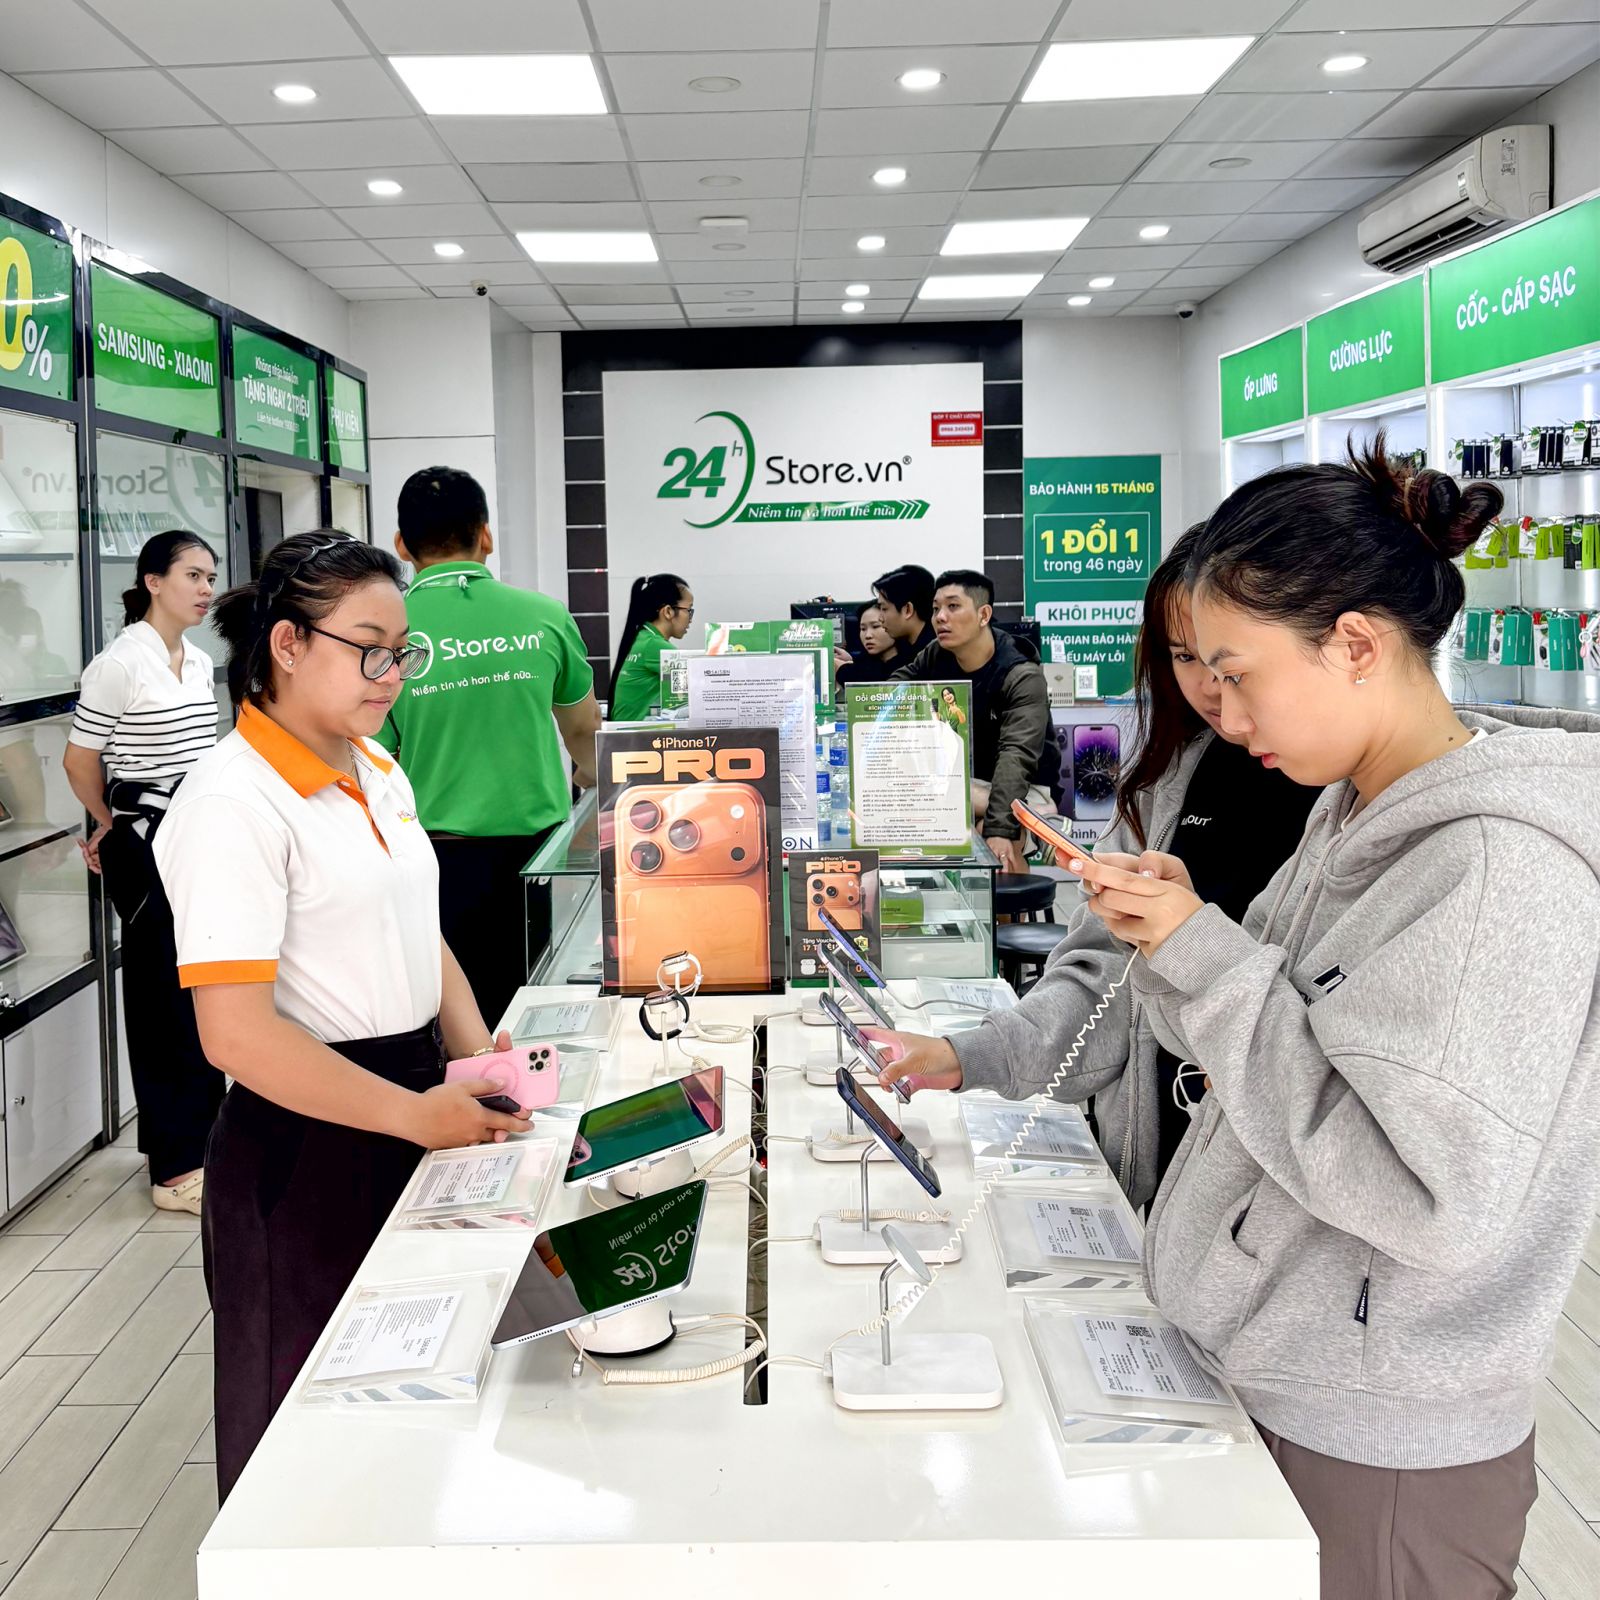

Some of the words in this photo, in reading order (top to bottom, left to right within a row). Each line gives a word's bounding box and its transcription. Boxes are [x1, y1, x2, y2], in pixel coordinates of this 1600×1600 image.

[1456, 289, 1488, 330] CỐC
[1502, 276, 1535, 315] CÁP
[1539, 266, 1576, 307] SẠC
[98, 322, 166, 370] SAMSUNG
[174, 349, 214, 386] XIAOMI
[1330, 339, 1367, 372] CƯỜNG
[1369, 330, 1393, 363] LỰC
[1244, 375, 1255, 401] ỐP
[1255, 372, 1278, 397] LƯNG
[242, 374, 266, 404] TẶNG
[266, 384, 287, 411] NGAY
[287, 392, 292, 412] 2
[292, 394, 310, 421] TRIỆU
[330, 406, 344, 433] PHỤ
[1029, 481, 1055, 495] BẢO
[1057, 481, 1093, 495] HÀNH
[1095, 483, 1110, 494] 15
[1111, 480, 1155, 494] THÁNG
[748, 504, 781, 519] Niềm
[785, 506, 801, 518] tin
[805, 506, 820, 517] và
[823, 505, 846, 517] hơn
[873, 504, 896, 516] nữa
[1040, 529, 1054, 554] 1
[1062, 518, 1117, 554] ĐỔI
[1124, 528, 1139, 553] 1
[1043, 558, 1082, 574] trong
[1085, 558, 1104, 571] 46
[1107, 557, 1143, 574] ngày
[1048, 604, 1087, 621] KHÔI
[1091, 606, 1136, 623] PHỤC
[1063, 635, 1091, 645] GIAN
[1093, 632, 1114, 644] BẢO
[1117, 632, 1141, 644] HÀN
[1066, 650, 1080, 662] ẾU
[1083, 650, 1106, 662] MÁY
[1108, 649, 1125, 662] LỖI
[440, 681, 455, 691] tin
[457, 677, 469, 688] và
[493, 670, 511, 682] thế
[870, 692, 894, 701] eSIM
[662, 737, 704, 749] iPhone
[704, 736, 717, 747] 17
[611, 748, 766, 784] PRO
[805, 860, 861, 874] PRO
